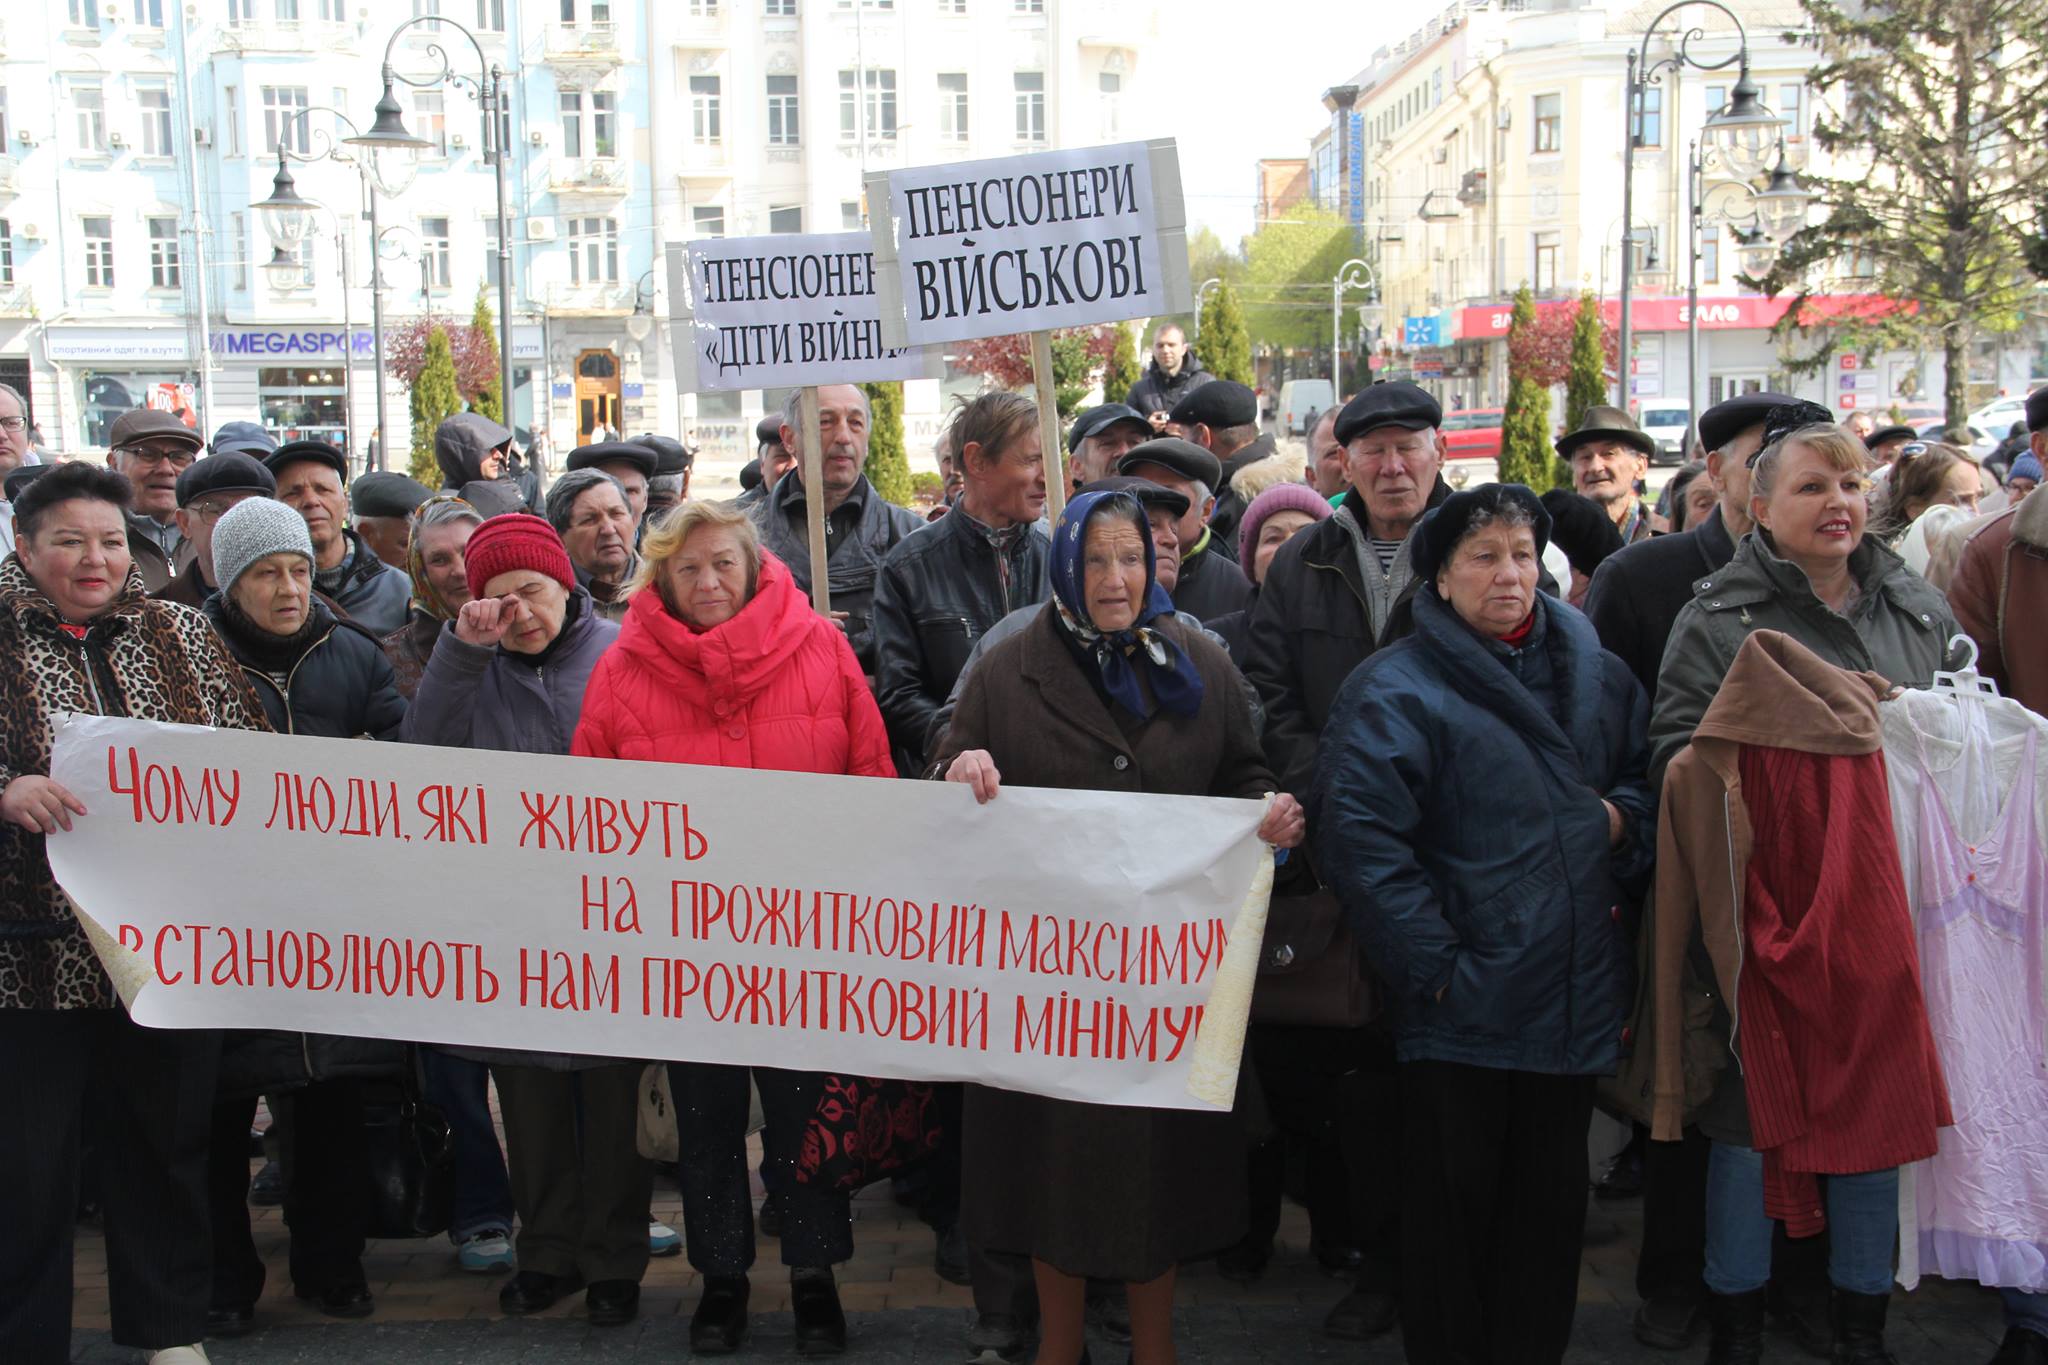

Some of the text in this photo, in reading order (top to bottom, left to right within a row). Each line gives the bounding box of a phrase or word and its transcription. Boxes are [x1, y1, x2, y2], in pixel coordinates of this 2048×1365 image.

[905, 164, 1138, 238] ПЕНСІОНЕРИ
[913, 236, 1147, 320] ВІЙСЬКОВІ
[53, 345, 111, 355] спортивний
[114, 346, 136, 355] одяг
[139, 346, 149, 354] та
[706, 323, 792, 377] «ДІТИ
[914, 421, 944, 436] МУ
[520, 791, 708, 860] ЖИВУТЬ
[672, 880, 986, 967] ПРОЖИТКОВИЙ
[643, 958, 988, 1050] ПРОЖИТКОВИЙ
[1014, 990, 1205, 1062] МІНІМУ
